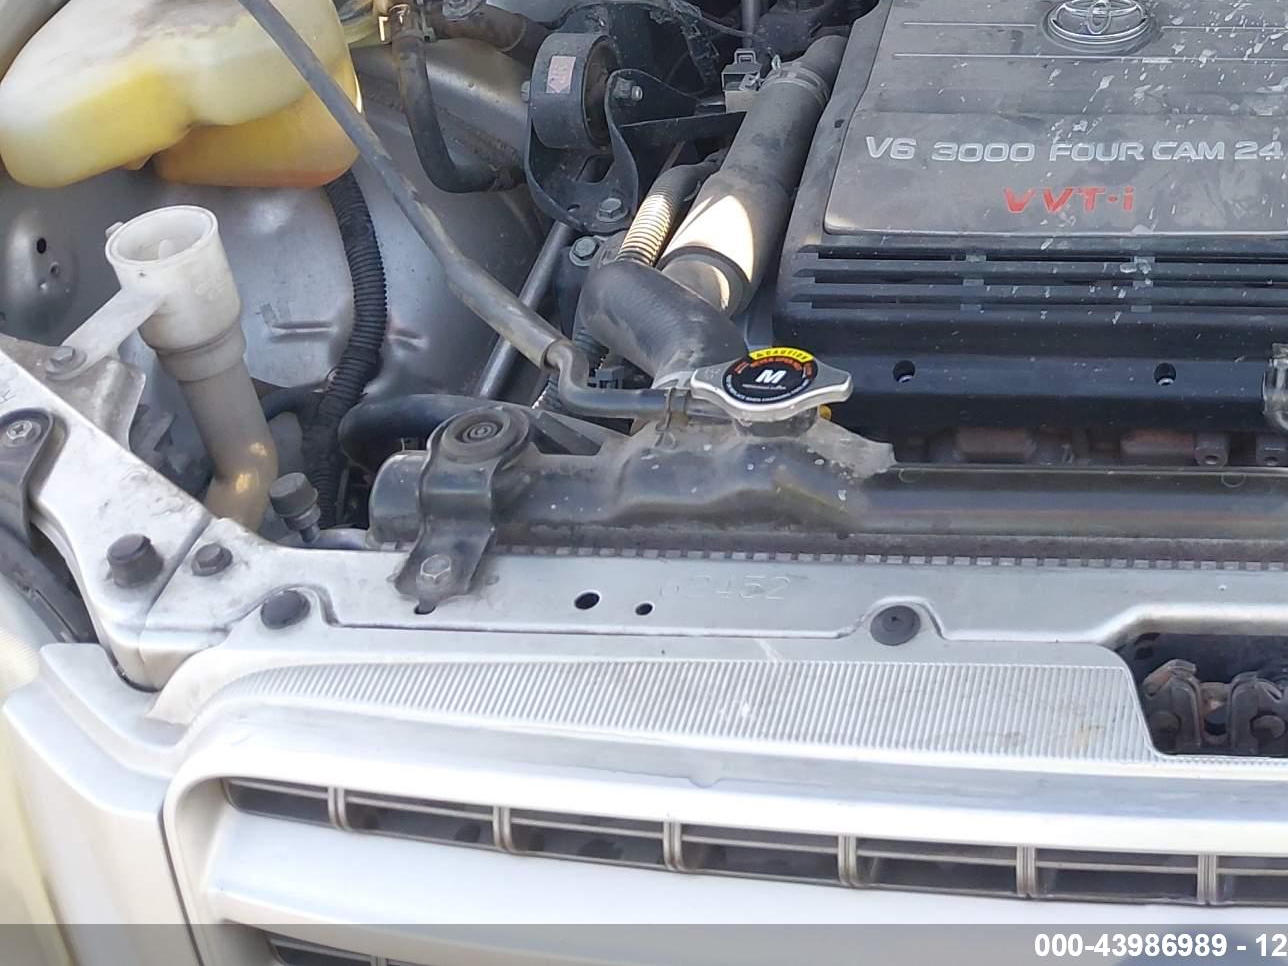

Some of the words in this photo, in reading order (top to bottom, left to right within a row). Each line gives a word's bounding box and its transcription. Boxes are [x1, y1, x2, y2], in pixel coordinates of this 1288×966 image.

[865, 137, 917, 160] V6
[931, 141, 1036, 162] 3000
[1049, 141, 1145, 162] FOUR
[1152, 141, 1225, 161] CAM
[1234, 141, 1281, 160] 24
[765, 348, 810, 361] CAUTION
[755, 369, 787, 384] M
